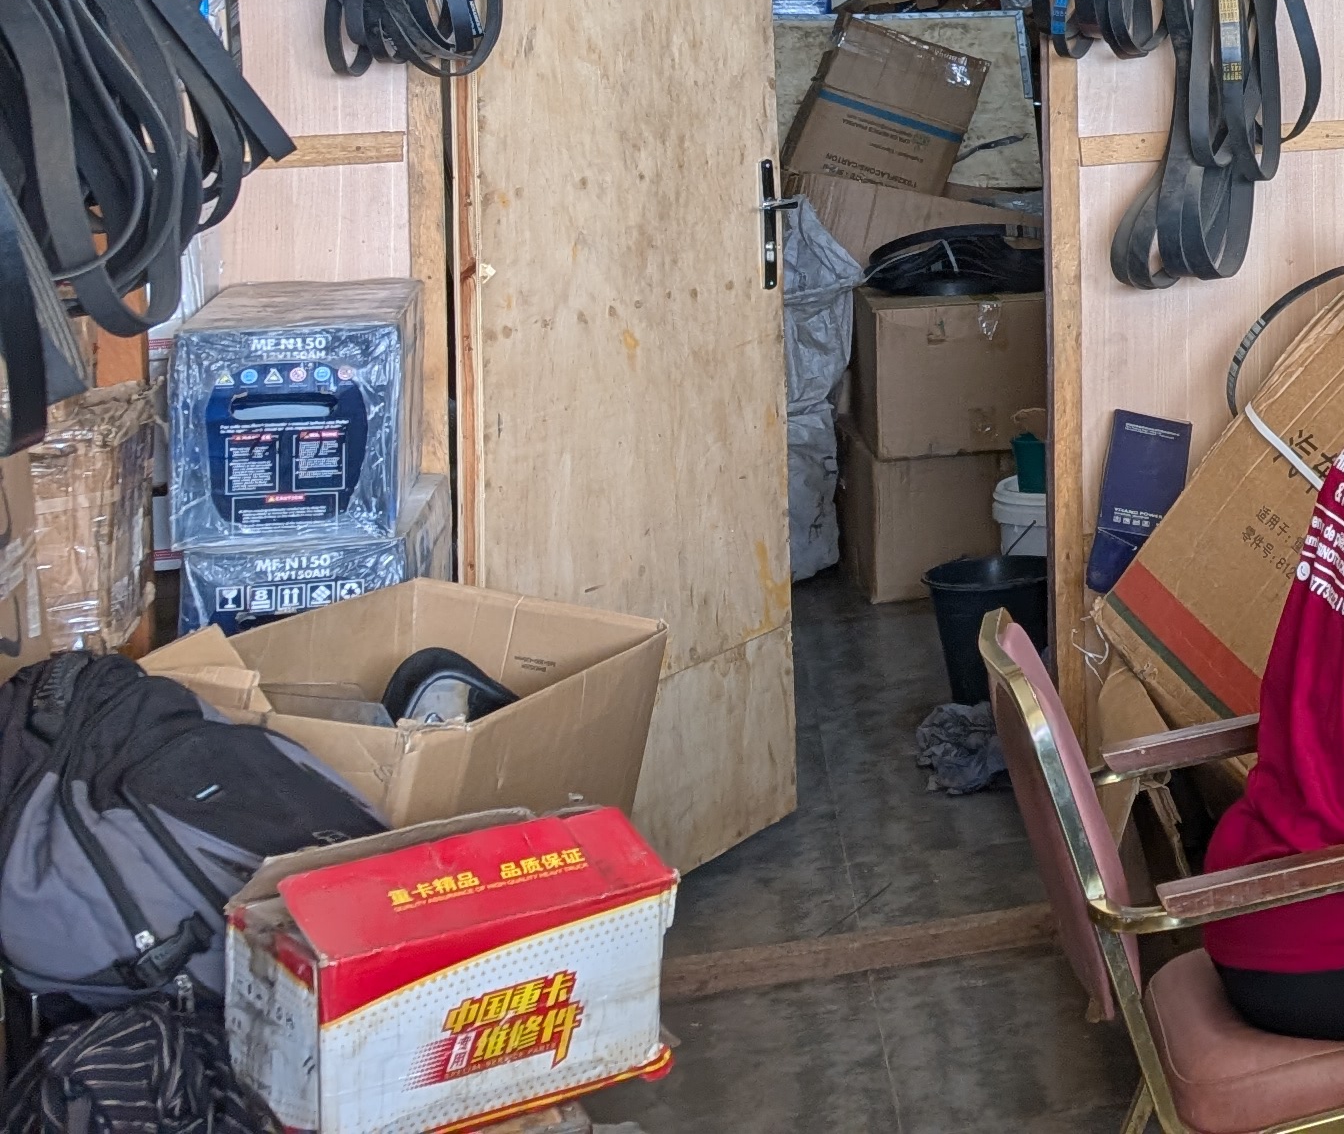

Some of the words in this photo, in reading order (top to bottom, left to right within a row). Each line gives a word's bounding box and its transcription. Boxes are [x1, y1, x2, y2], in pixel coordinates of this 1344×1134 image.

[388, 872, 480, 906] 重卡精品
[500, 848, 586, 879] 品质保证
[443, 970, 577, 1035] 中国重卡
[450, 1033, 473, 1070] 专用
[471, 1000, 584, 1068] 维修件
